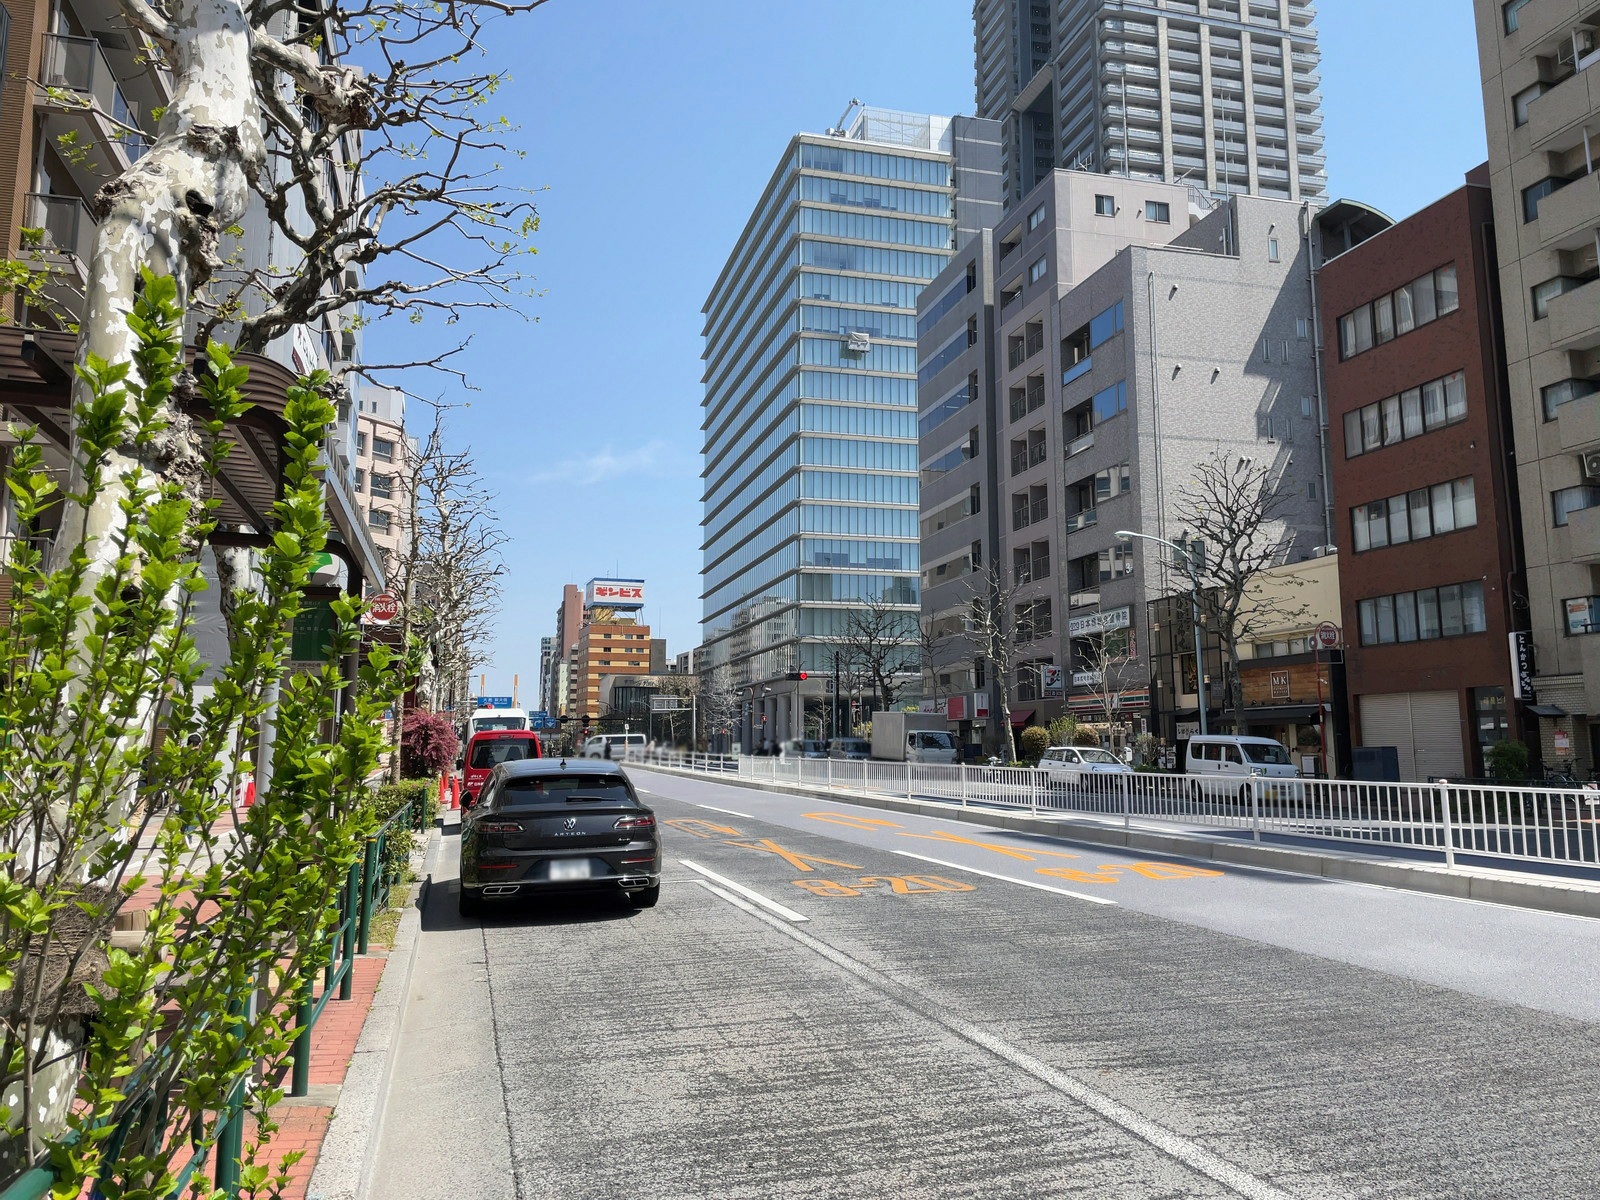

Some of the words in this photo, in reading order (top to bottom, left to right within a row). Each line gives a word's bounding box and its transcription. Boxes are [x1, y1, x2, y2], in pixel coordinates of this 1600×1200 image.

[595, 586, 643, 598] ギンビス
[372, 602, 397, 613] 消火栓
[1518, 635, 1528, 670] とんかつ
[790, 874, 978, 898] 8-20
